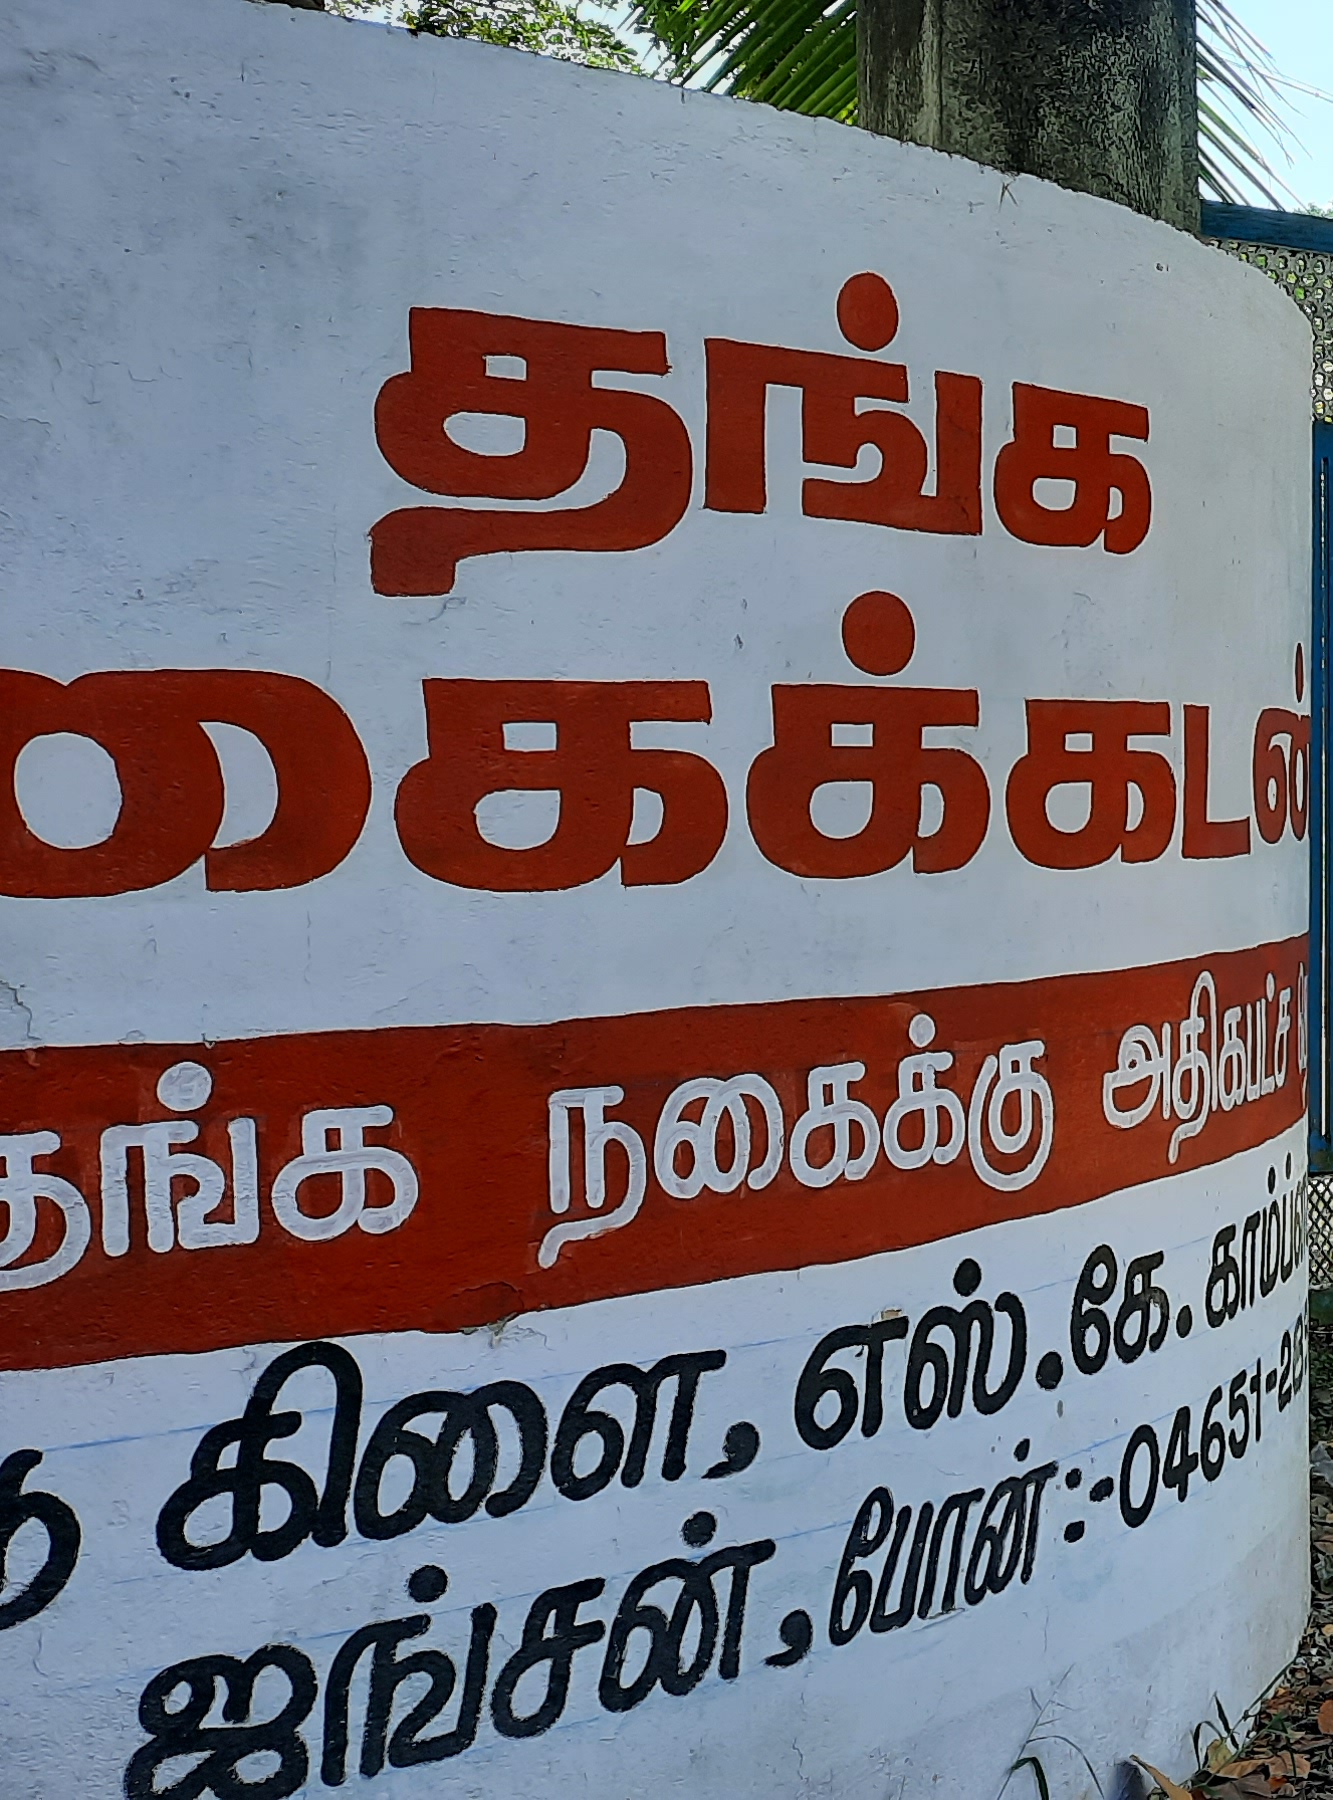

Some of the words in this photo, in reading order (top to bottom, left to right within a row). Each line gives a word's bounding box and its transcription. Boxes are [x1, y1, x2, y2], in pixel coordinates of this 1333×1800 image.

[369, 271, 1152, 596] தங்க
[537, 1012, 1055, 1271] நகைக்கு
[1103, 970, 1292, 1164] அதிகபட்ச
[155, 1341, 760, 1571] கிளை,
